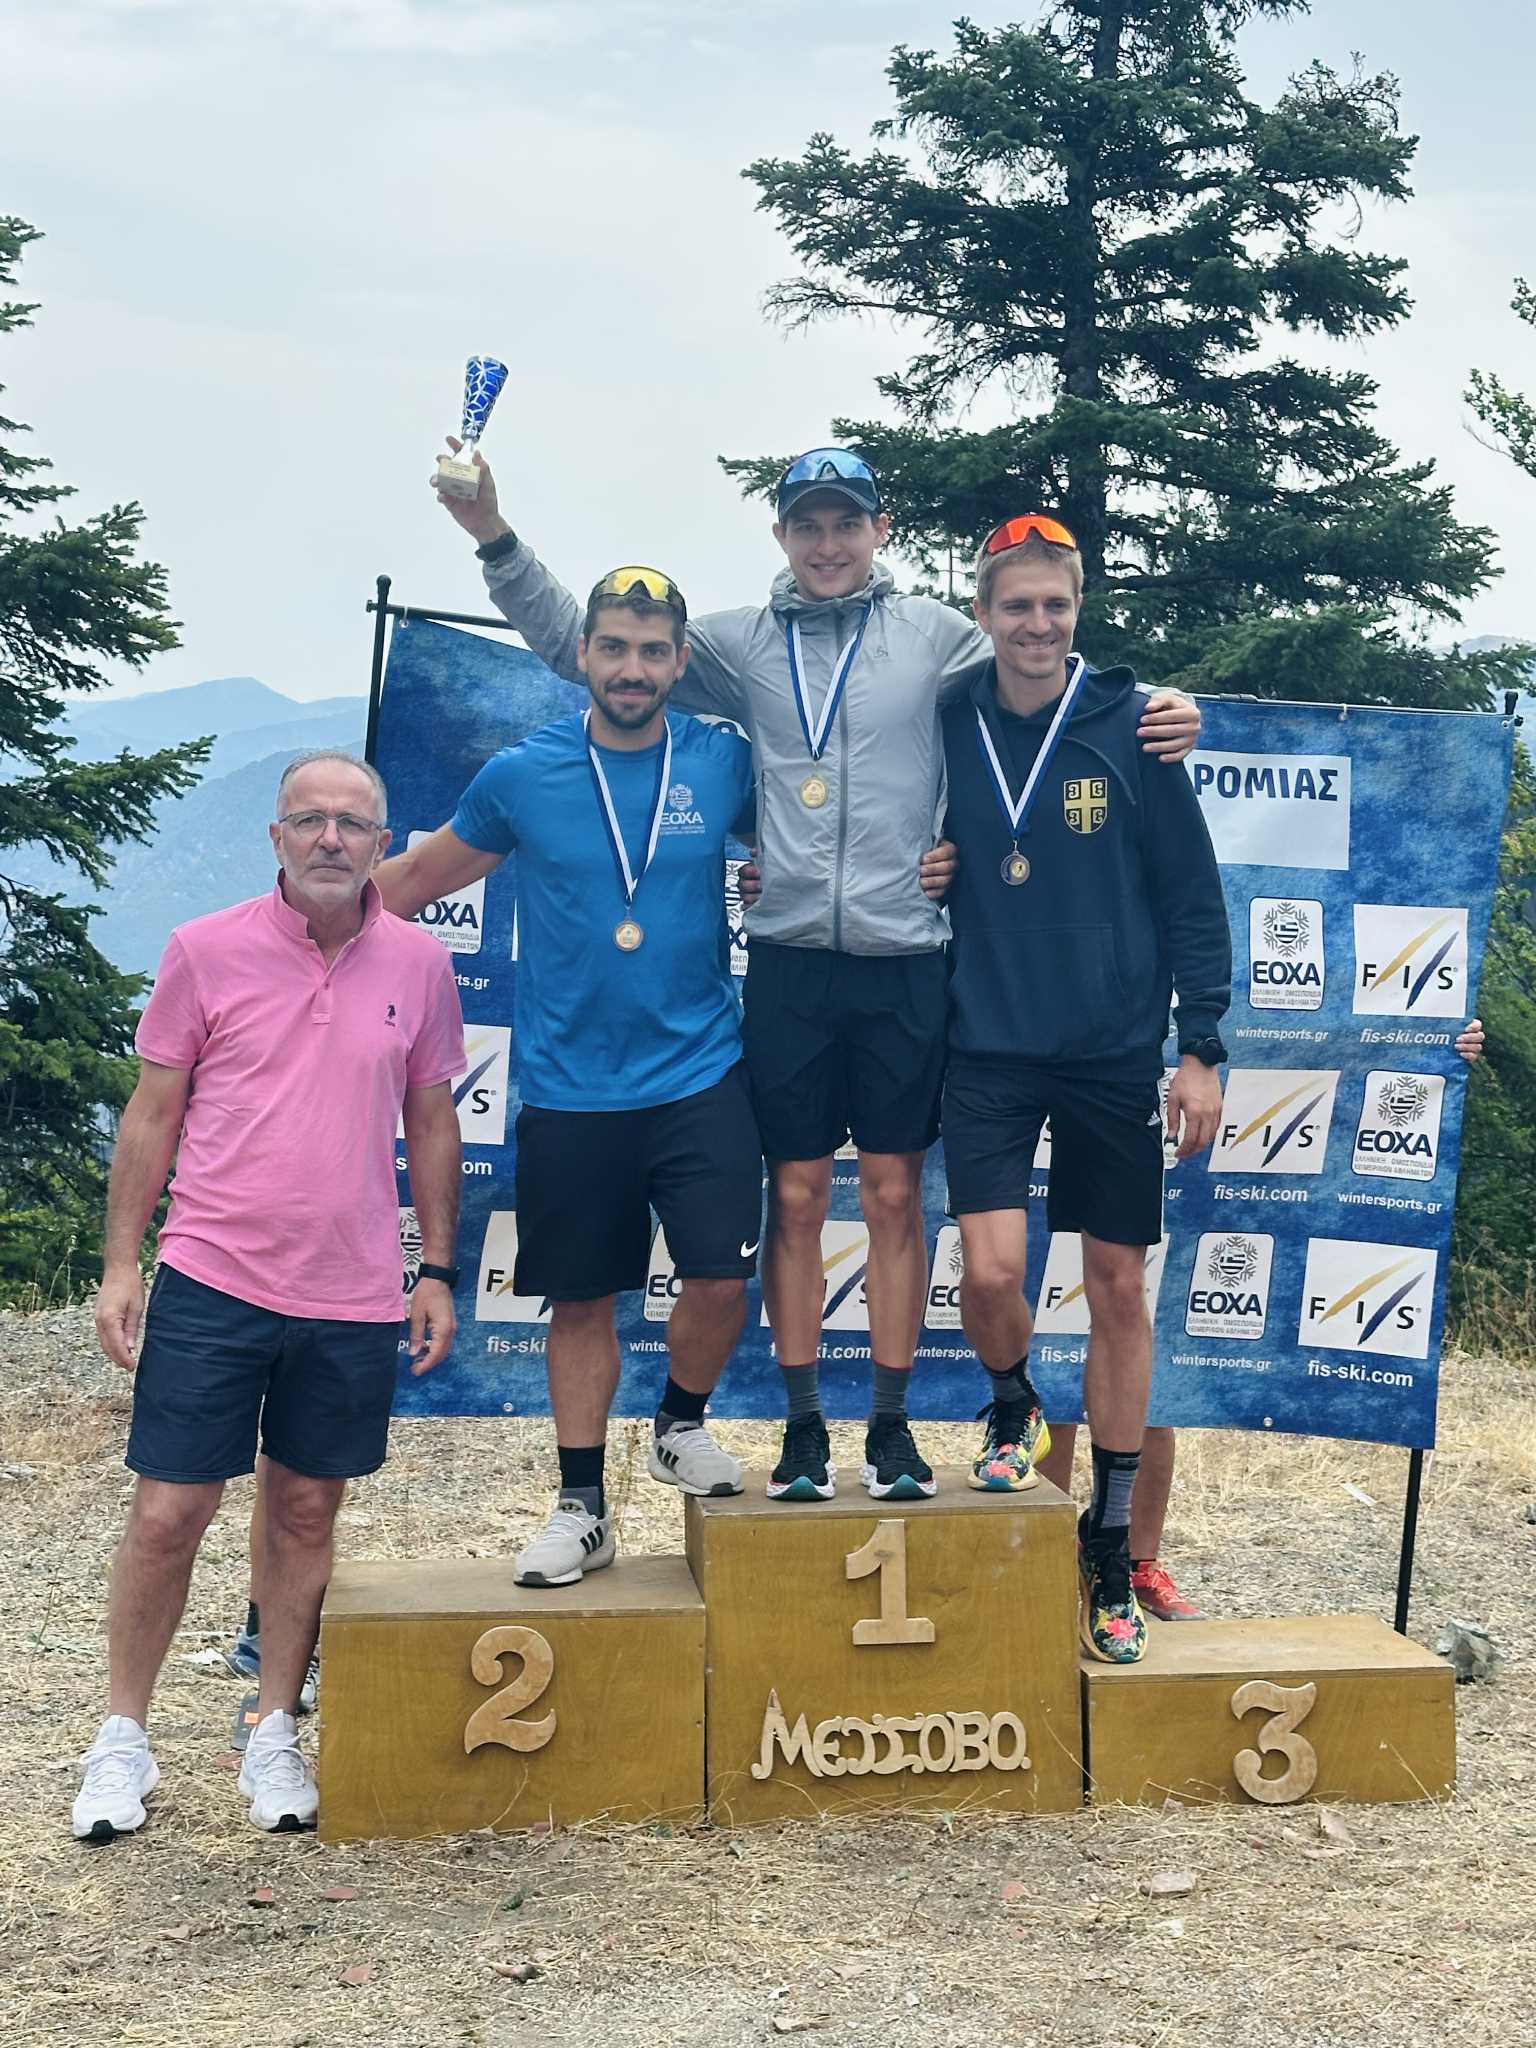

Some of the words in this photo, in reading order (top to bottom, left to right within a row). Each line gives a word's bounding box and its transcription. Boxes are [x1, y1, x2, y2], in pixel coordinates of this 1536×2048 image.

[407, 900, 479, 929] ΟΧΑ
[1252, 961, 1321, 986] ΕΟΧΑ
[1361, 963, 1454, 991] FIS
[1235, 1026, 1329, 1043] wintersports.gr
[1359, 1027, 1450, 1046] fis-ski.com
[1221, 1124, 1314, 1149] FIS
[1357, 1129, 1433, 1158] ΕΟΧΑ
[1213, 1184, 1308, 1202] fis-ski.com
[1337, 1191, 1443, 1214] wintersports.gr
[1189, 1290, 1263, 1317] ΕΟΧΑ
[1309, 1296, 1415, 1330] FIS
[486, 1335, 547, 1354] fis-ski
[1171, 1355, 1272, 1371] wintersports.gr
[1307, 1359, 1414, 1388] fis-ski.com
[845, 1518, 936, 1646] 1
[464, 1625, 557, 1755] 2
[1230, 1679, 1318, 1804] 3
